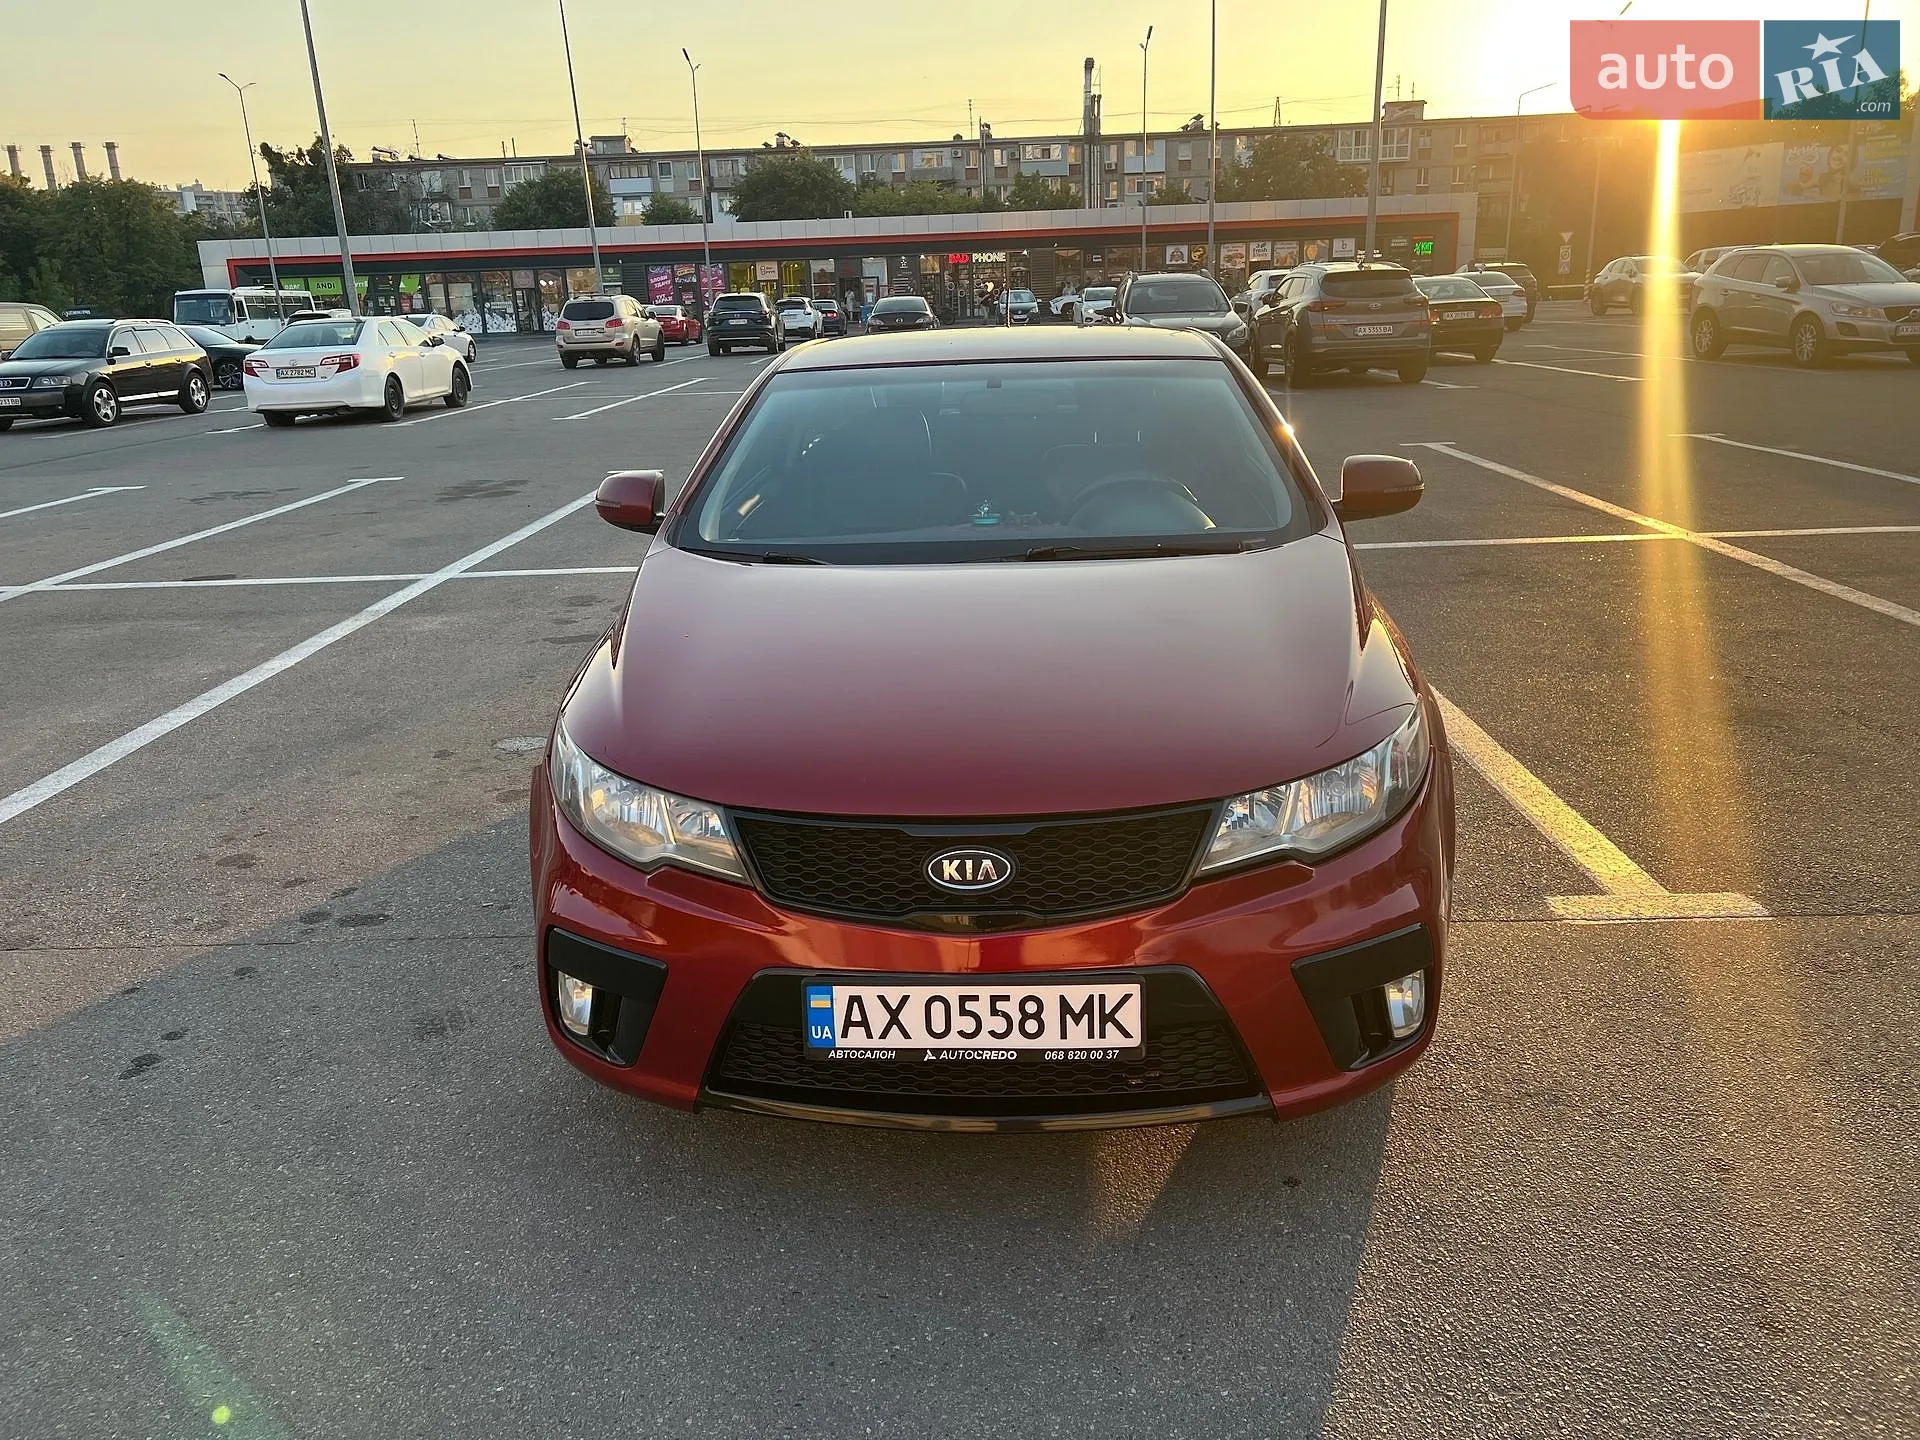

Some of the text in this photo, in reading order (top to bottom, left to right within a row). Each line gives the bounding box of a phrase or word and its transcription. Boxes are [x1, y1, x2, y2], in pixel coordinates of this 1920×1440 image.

[972, 252, 1006, 263] PHONE
[280, 368, 289, 376] AX
[942, 859, 998, 881] KIA
[841, 994, 1134, 1040] AX 0558 MK
[812, 1025, 833, 1039] UA
[828, 1050, 896, 1060] АВТОСАЛОН
[939, 1050, 1018, 1060] AUTOCREDO
[1044, 1050, 1120, 1060] 068 820 00 37
